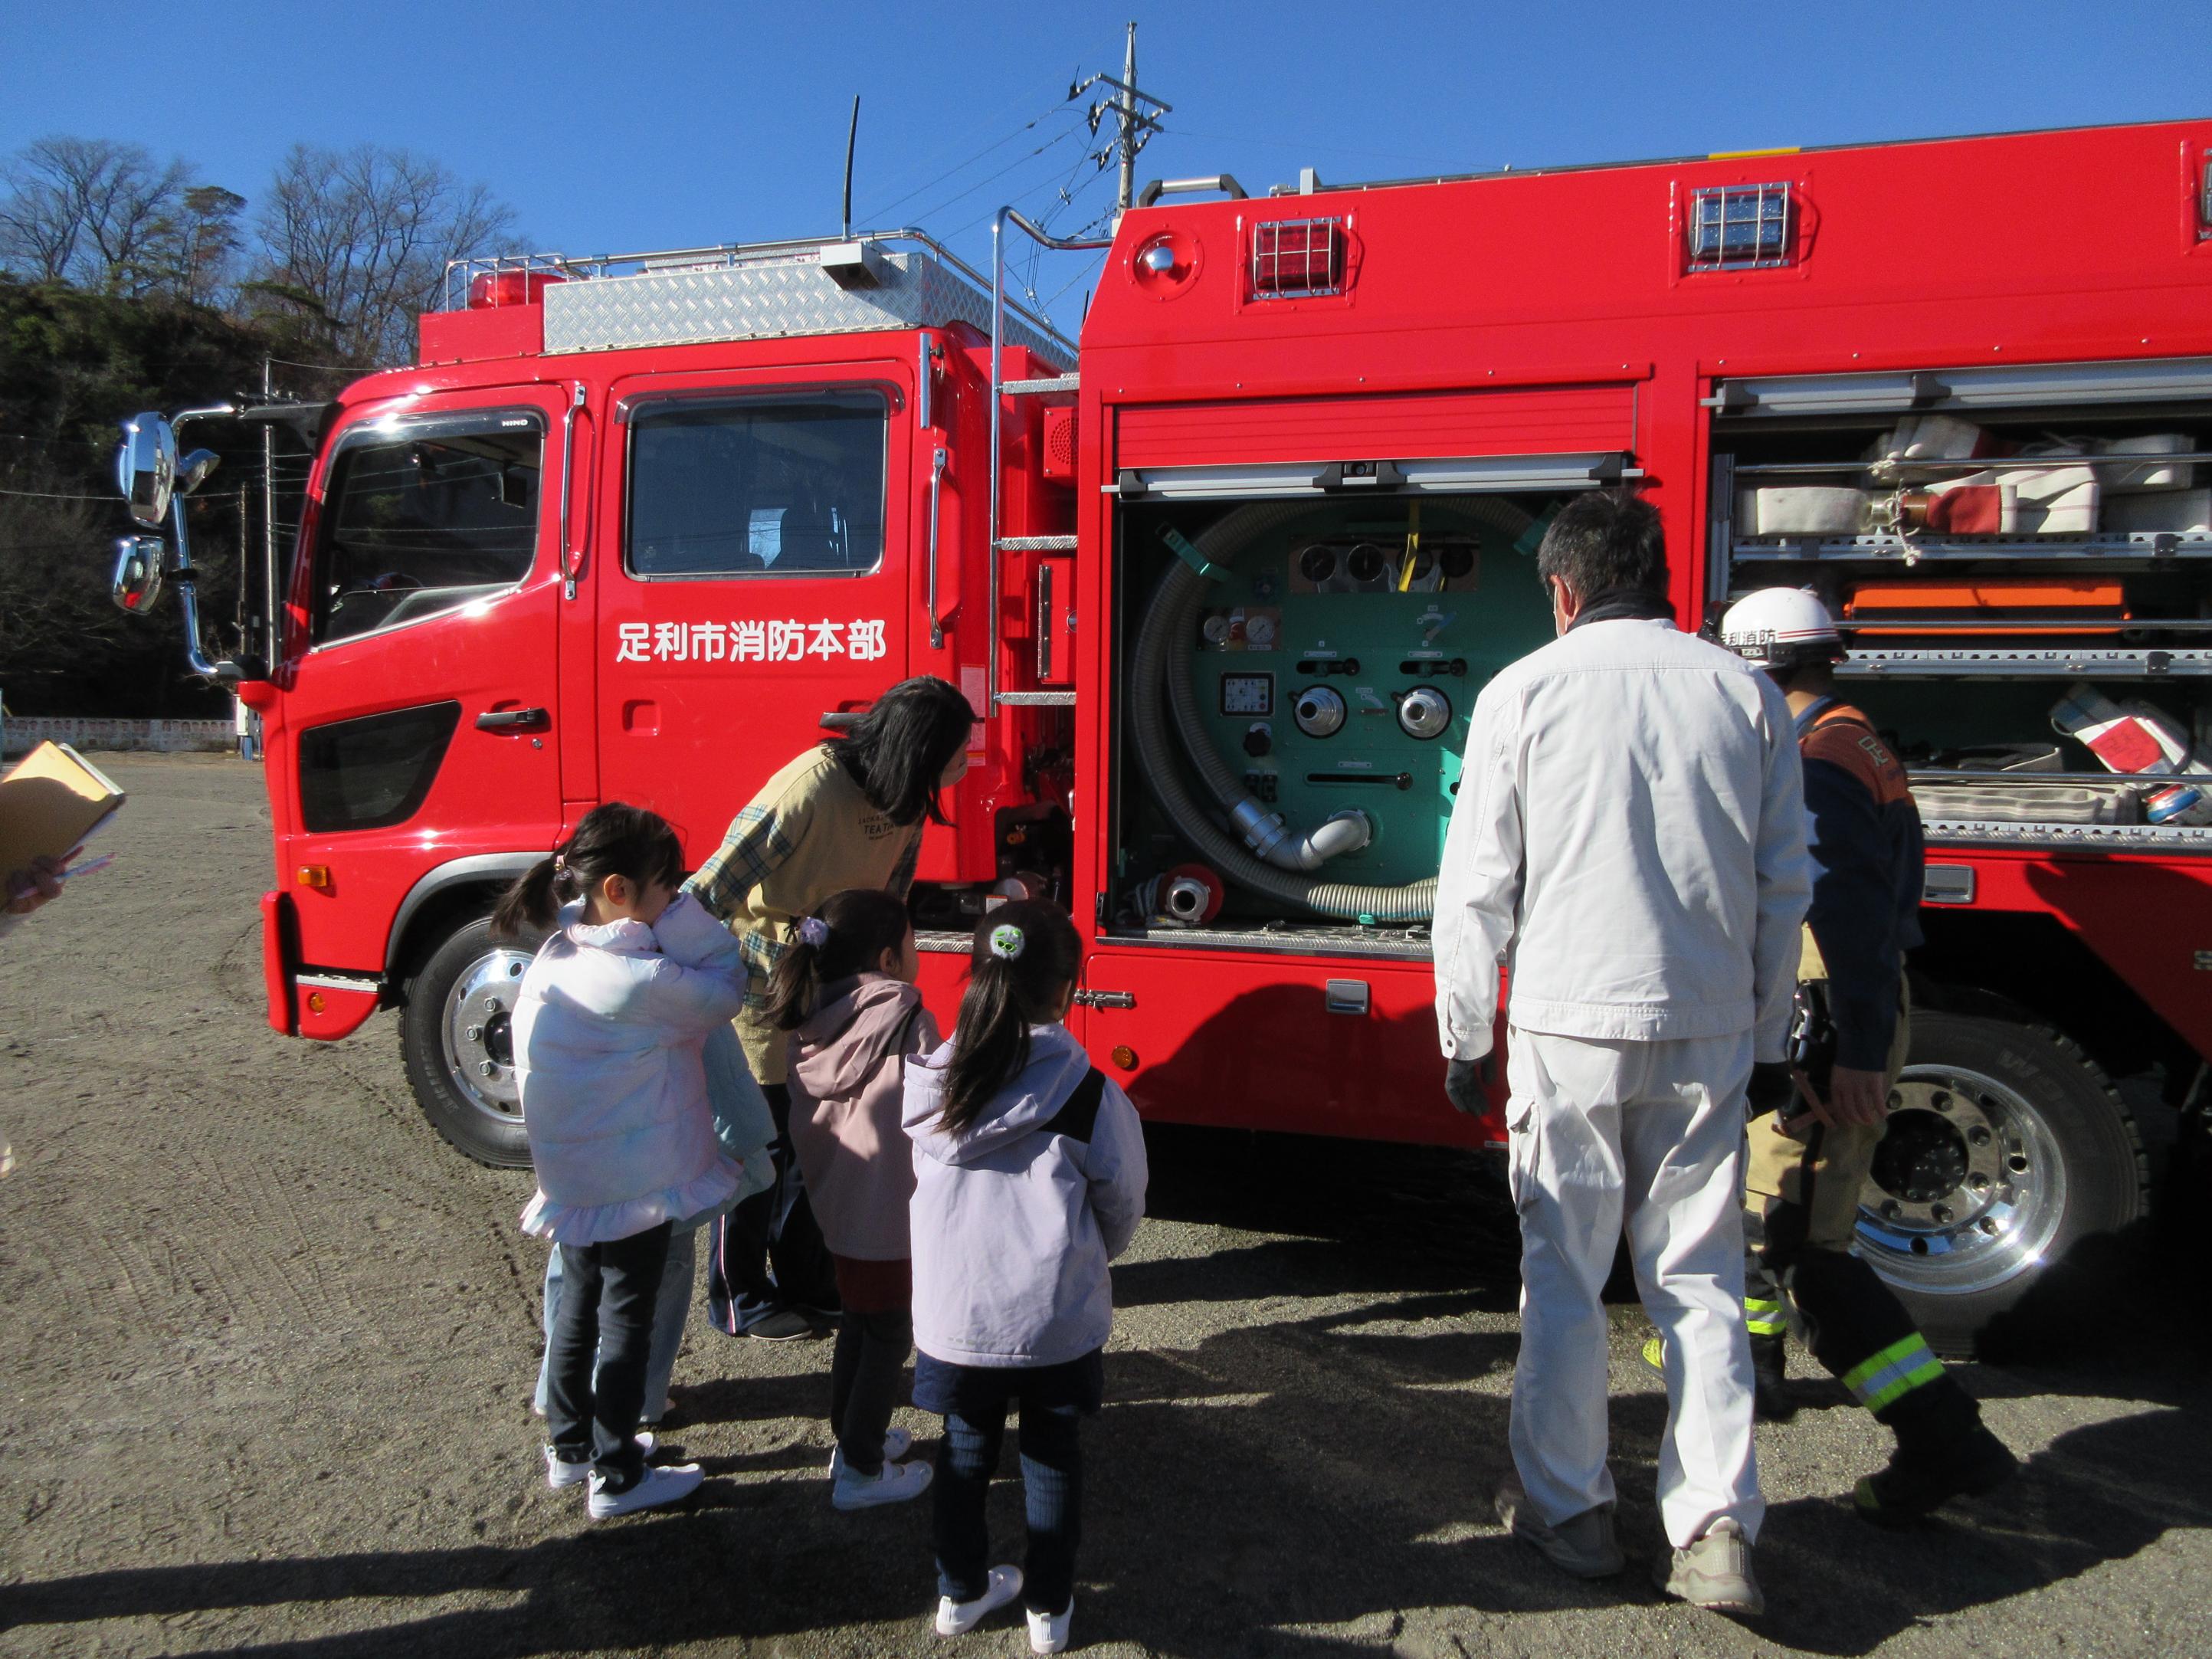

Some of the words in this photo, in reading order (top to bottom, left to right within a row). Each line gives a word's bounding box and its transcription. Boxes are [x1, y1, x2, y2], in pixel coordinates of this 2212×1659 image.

[616, 618, 886, 662] 足利市消防本部
[864, 825, 882, 835] TEA
